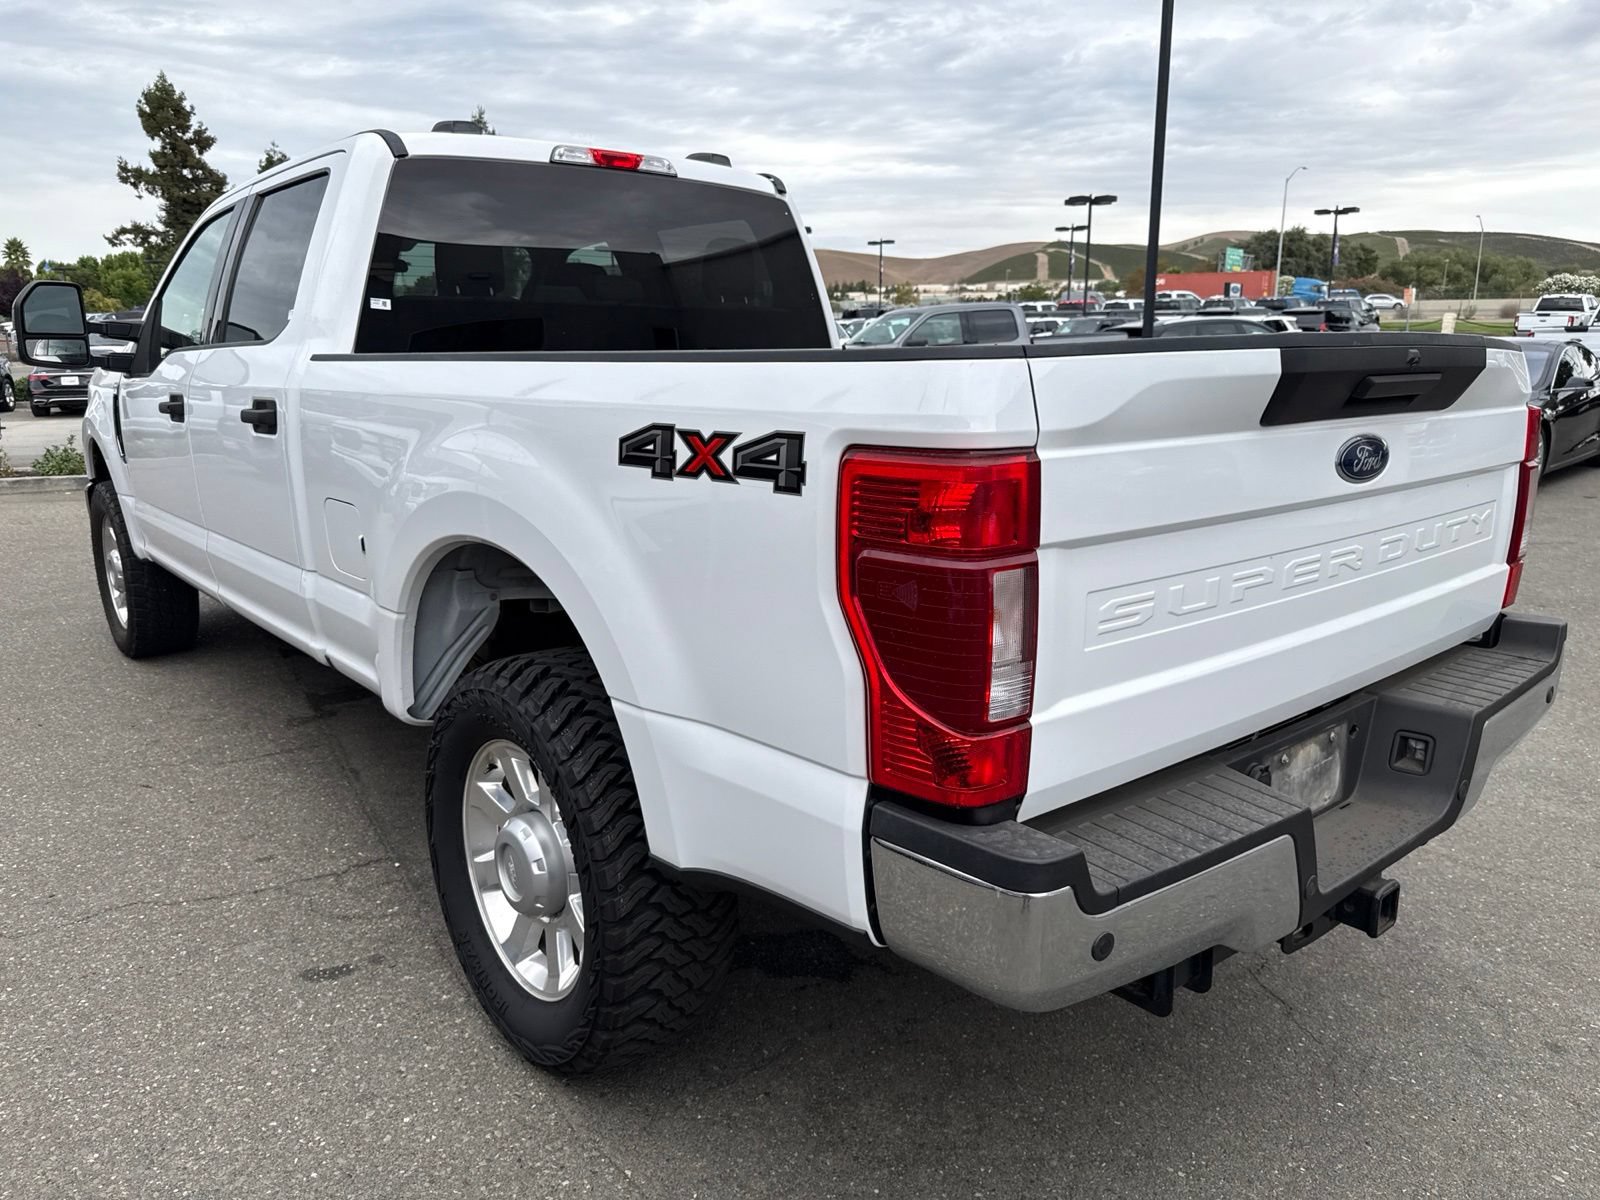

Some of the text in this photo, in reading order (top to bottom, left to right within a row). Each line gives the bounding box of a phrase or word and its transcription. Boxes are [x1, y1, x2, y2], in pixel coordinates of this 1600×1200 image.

[1353, 445, 1383, 473] Ford
[1097, 508, 1491, 635] SUPER DUTY
